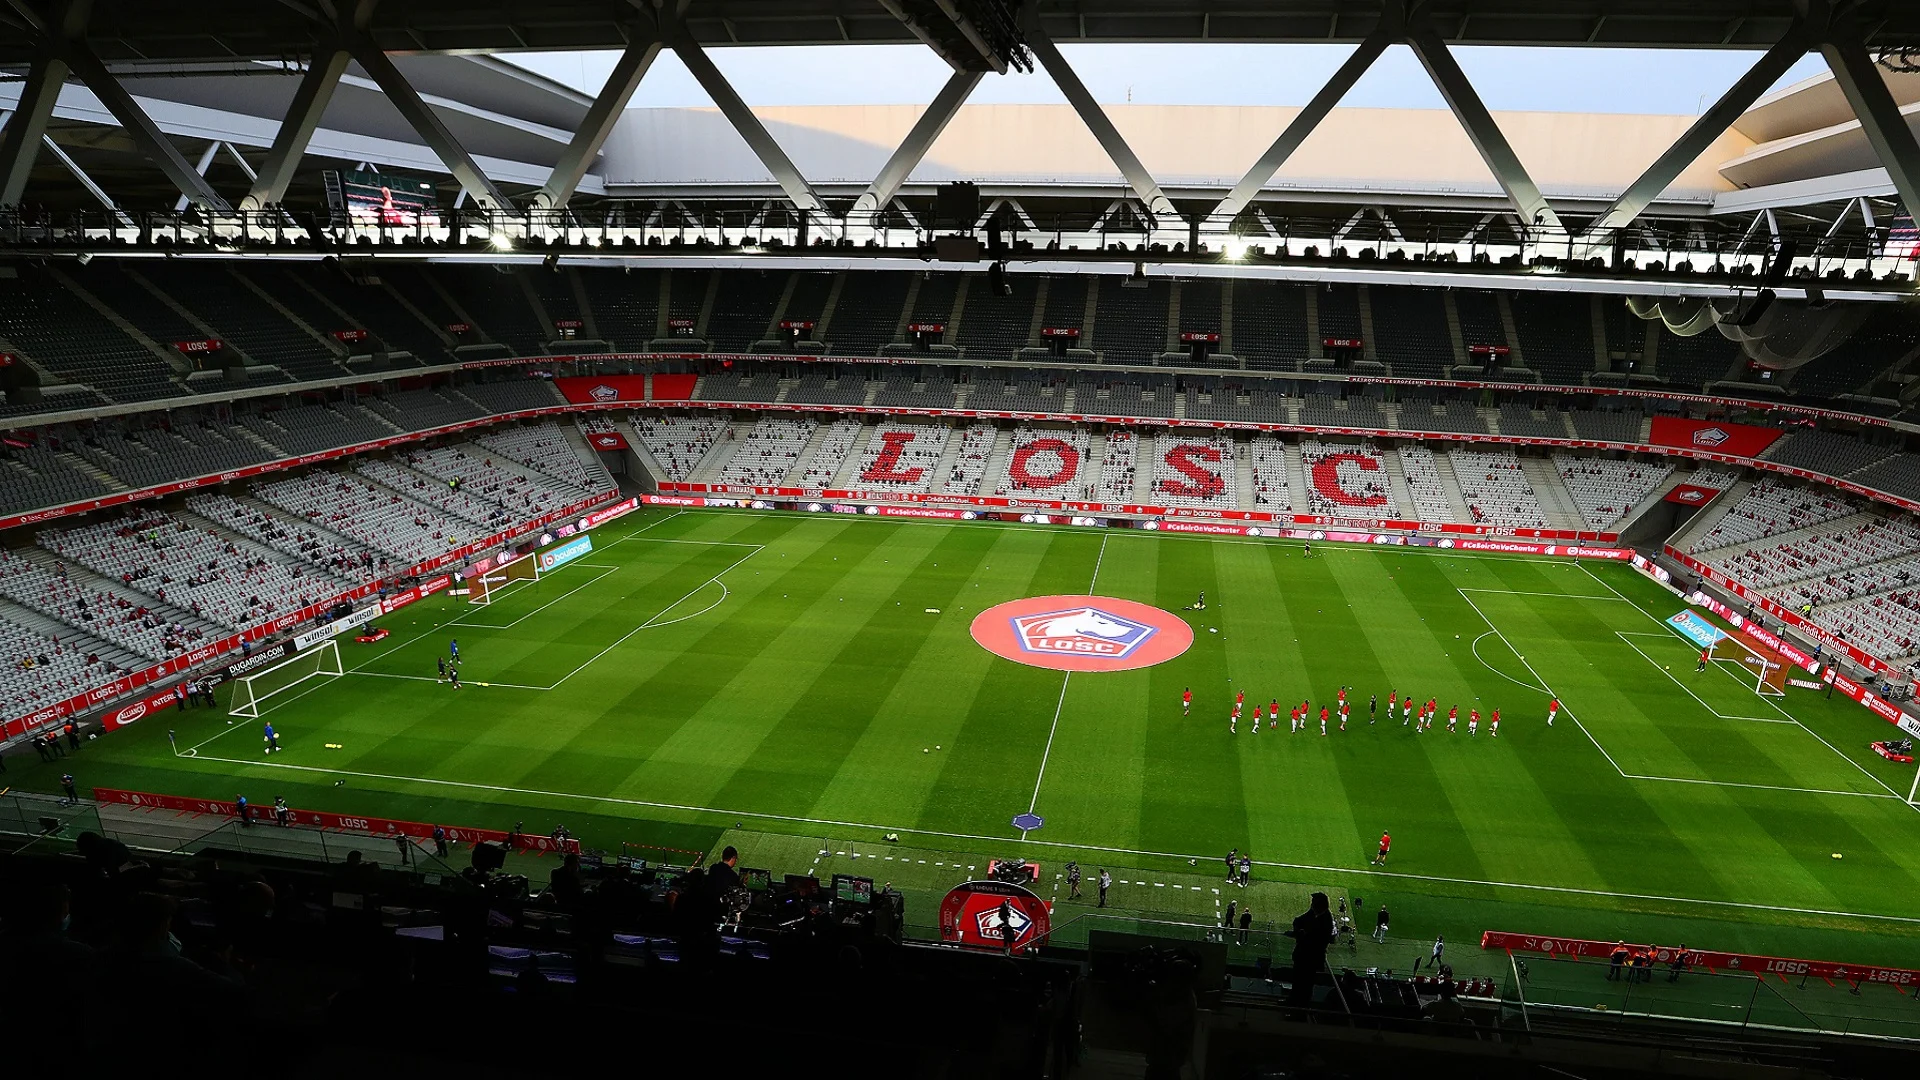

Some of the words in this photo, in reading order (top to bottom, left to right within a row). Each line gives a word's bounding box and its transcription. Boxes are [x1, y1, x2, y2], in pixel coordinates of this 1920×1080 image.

[343, 331, 357, 339] LOSC
[1191, 333, 1208, 341] LOSC
[186, 341, 208, 352] LOSC
[861, 430, 1390, 506] LOSC
[802, 489, 823, 498] LOSC
[1101, 504, 1123, 513] LOSC
[1271, 514, 1295, 522] LOSC
[1167, 524, 1241, 534] #CeSoirOnVaChanter
[1419, 523, 1442, 532] LOSC
[1491, 527, 1516, 537] LOSC
[554, 540, 590, 561] boulanger
[1462, 541, 1539, 553] #CeSoirOnVaChanter
[1578, 549, 1621, 559] boulanger
[276, 613, 300, 628] LOSC.fr
[1798, 620, 1820, 638] Crédit
[1824, 637, 1850, 656] Mutuel
[1037, 638, 1115, 654] LOSC
[188, 647, 216, 663] LOSC.fr
[228, 645, 285, 674] DUGARDIN.COM
[1790, 678, 1821, 690] WINAMAX
[91, 683, 124, 702] LOSC.fr
[28, 704, 66, 726] LOSC.fr
[340, 817, 369, 829] LOSC
[1767, 959, 1809, 974] LOSC
[1869, 969, 1912, 984] LOSC
